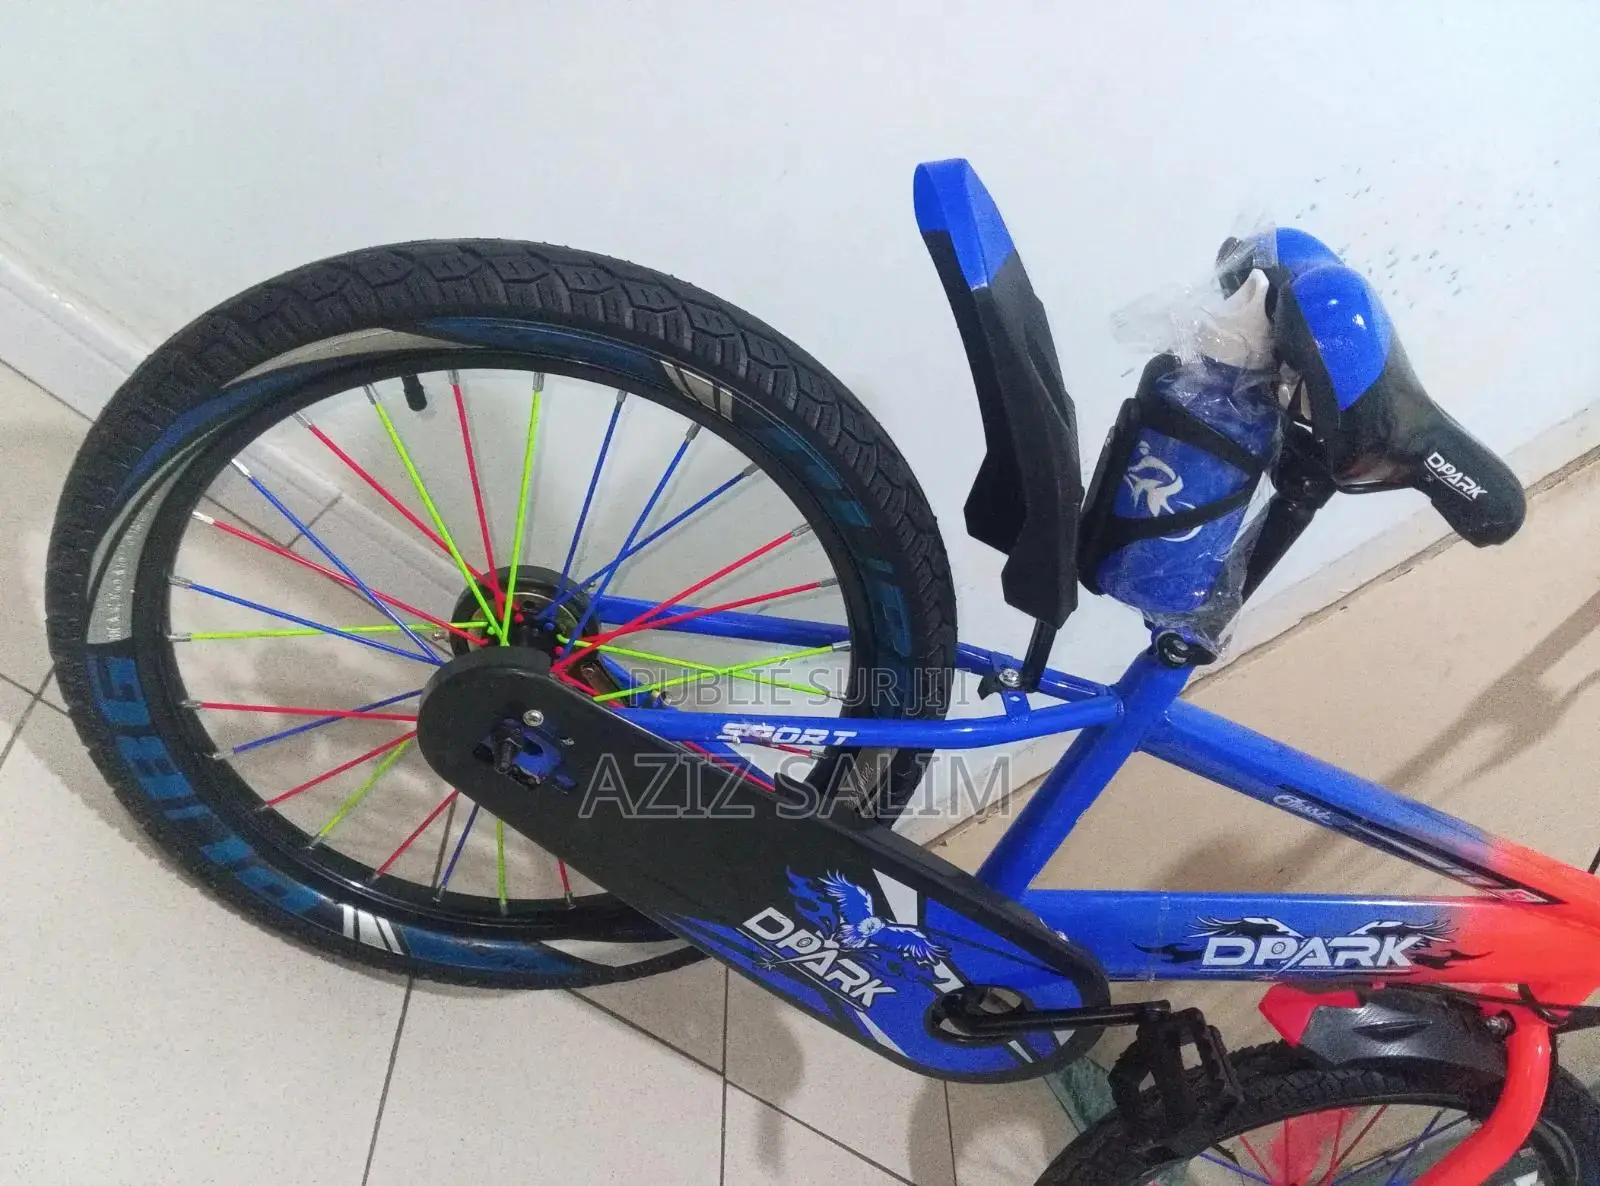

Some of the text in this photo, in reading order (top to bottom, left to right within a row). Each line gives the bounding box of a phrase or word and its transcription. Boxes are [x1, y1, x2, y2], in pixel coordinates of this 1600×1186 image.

[1426, 451, 1488, 499] DPARK
[716, 722, 858, 745] SPORT
[742, 906, 897, 1008] DPARK
[1202, 936, 1423, 968] DPARK
